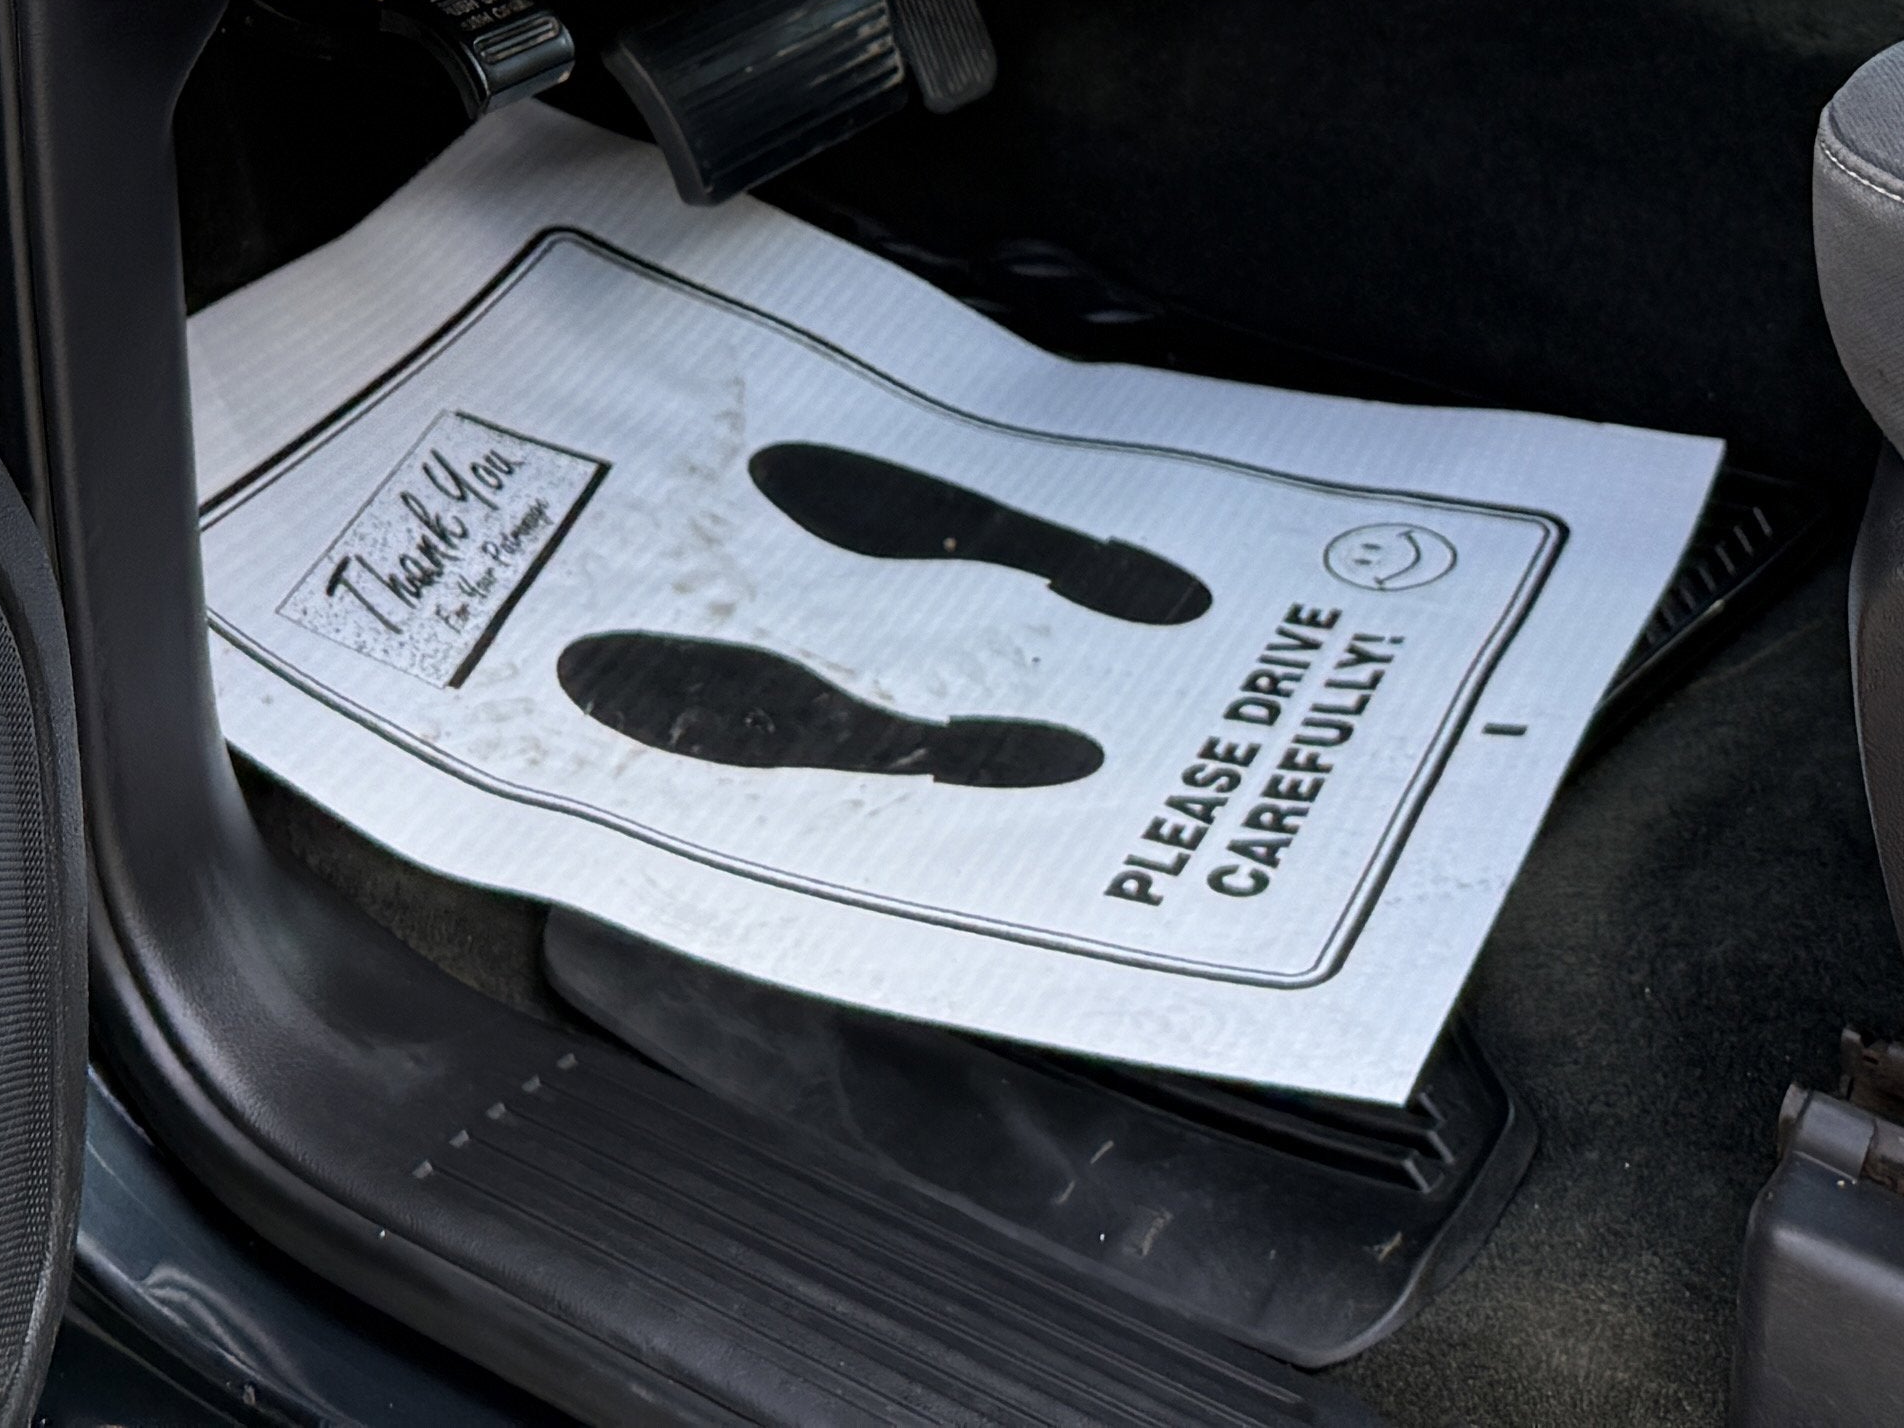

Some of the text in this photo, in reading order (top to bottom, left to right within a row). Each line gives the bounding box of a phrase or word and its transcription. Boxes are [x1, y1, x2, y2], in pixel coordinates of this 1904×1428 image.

[325, 447, 524, 635] Thank You
[1103, 602, 1343, 907] PLEASE DRIVE
[1206, 632, 1405, 898] CAREFULLY!
